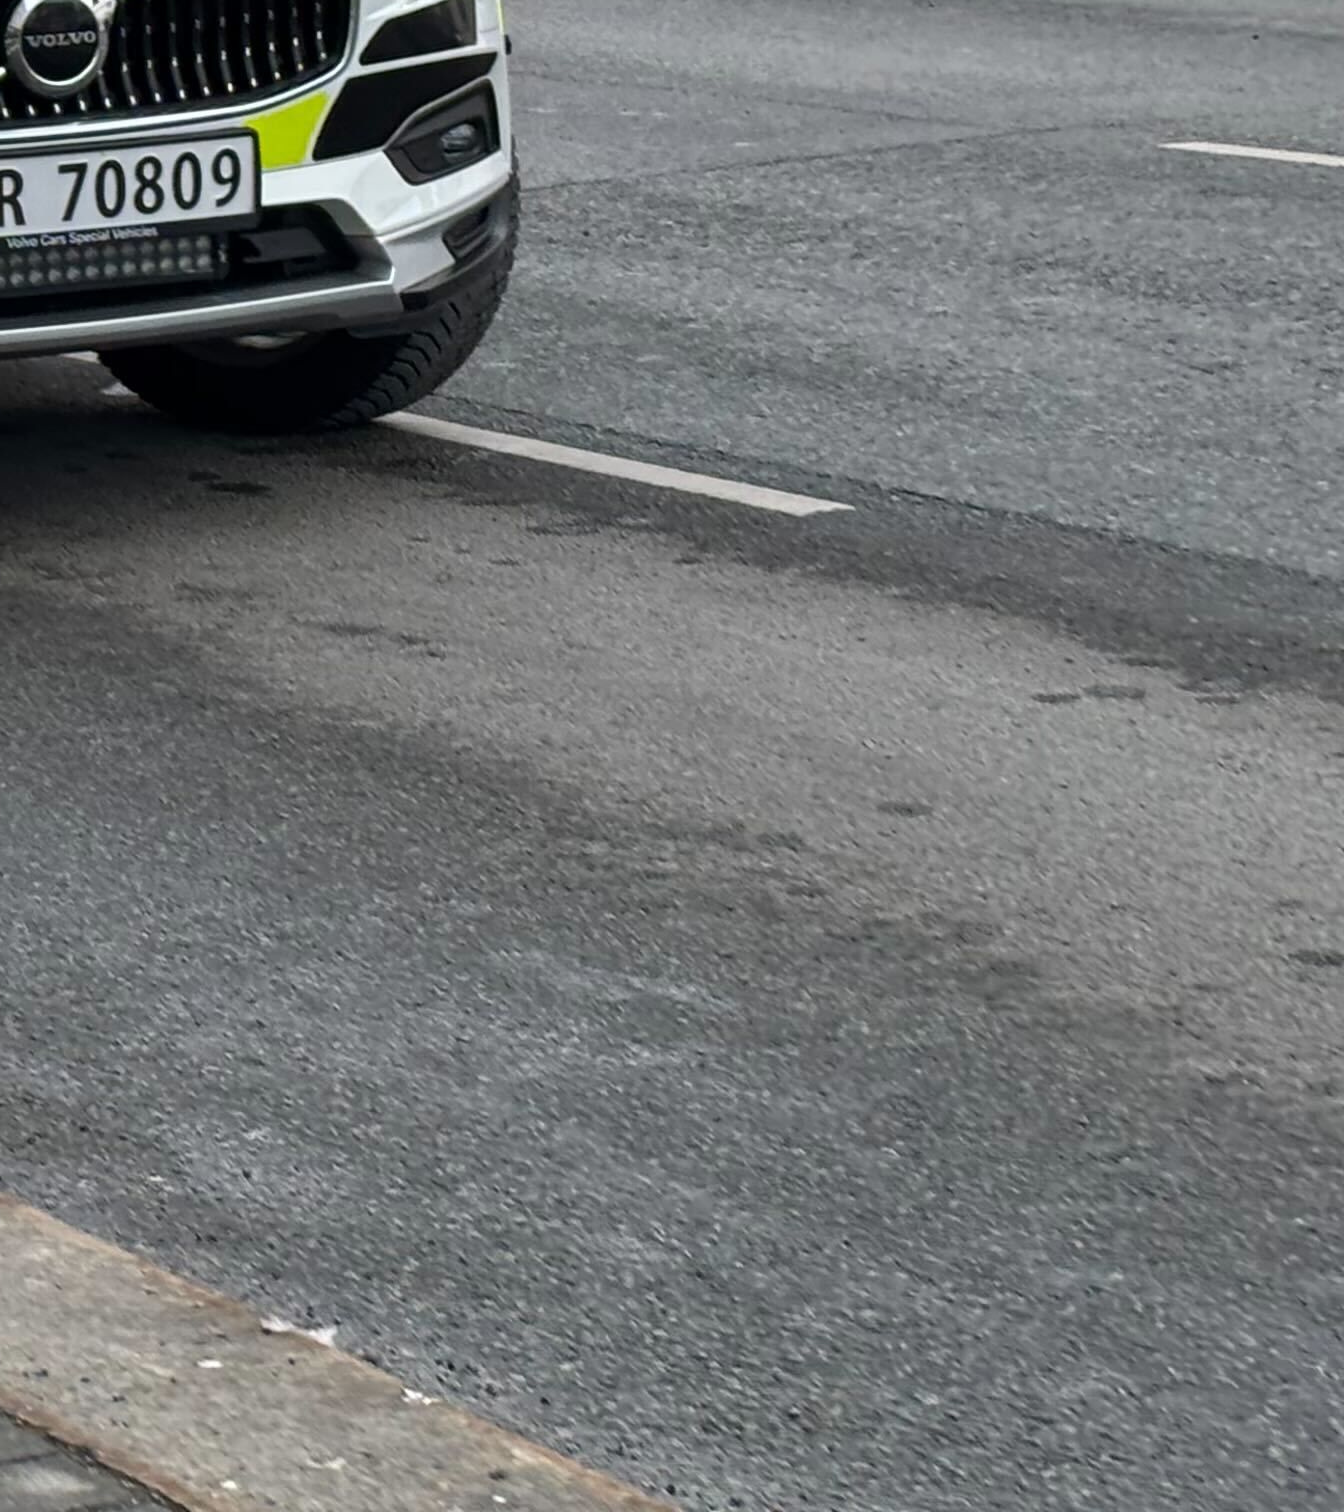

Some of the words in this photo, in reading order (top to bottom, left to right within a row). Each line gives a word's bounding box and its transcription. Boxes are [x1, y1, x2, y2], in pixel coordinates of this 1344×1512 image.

[24, 30, 97, 48] VOLVO
[57, 148, 242, 222] 70809
[6, 237, 39, 249] Volvo
[40, 234, 67, 246] Cars
[68, 229, 110, 245] Special
[113, 226, 159, 240] Vehicles
